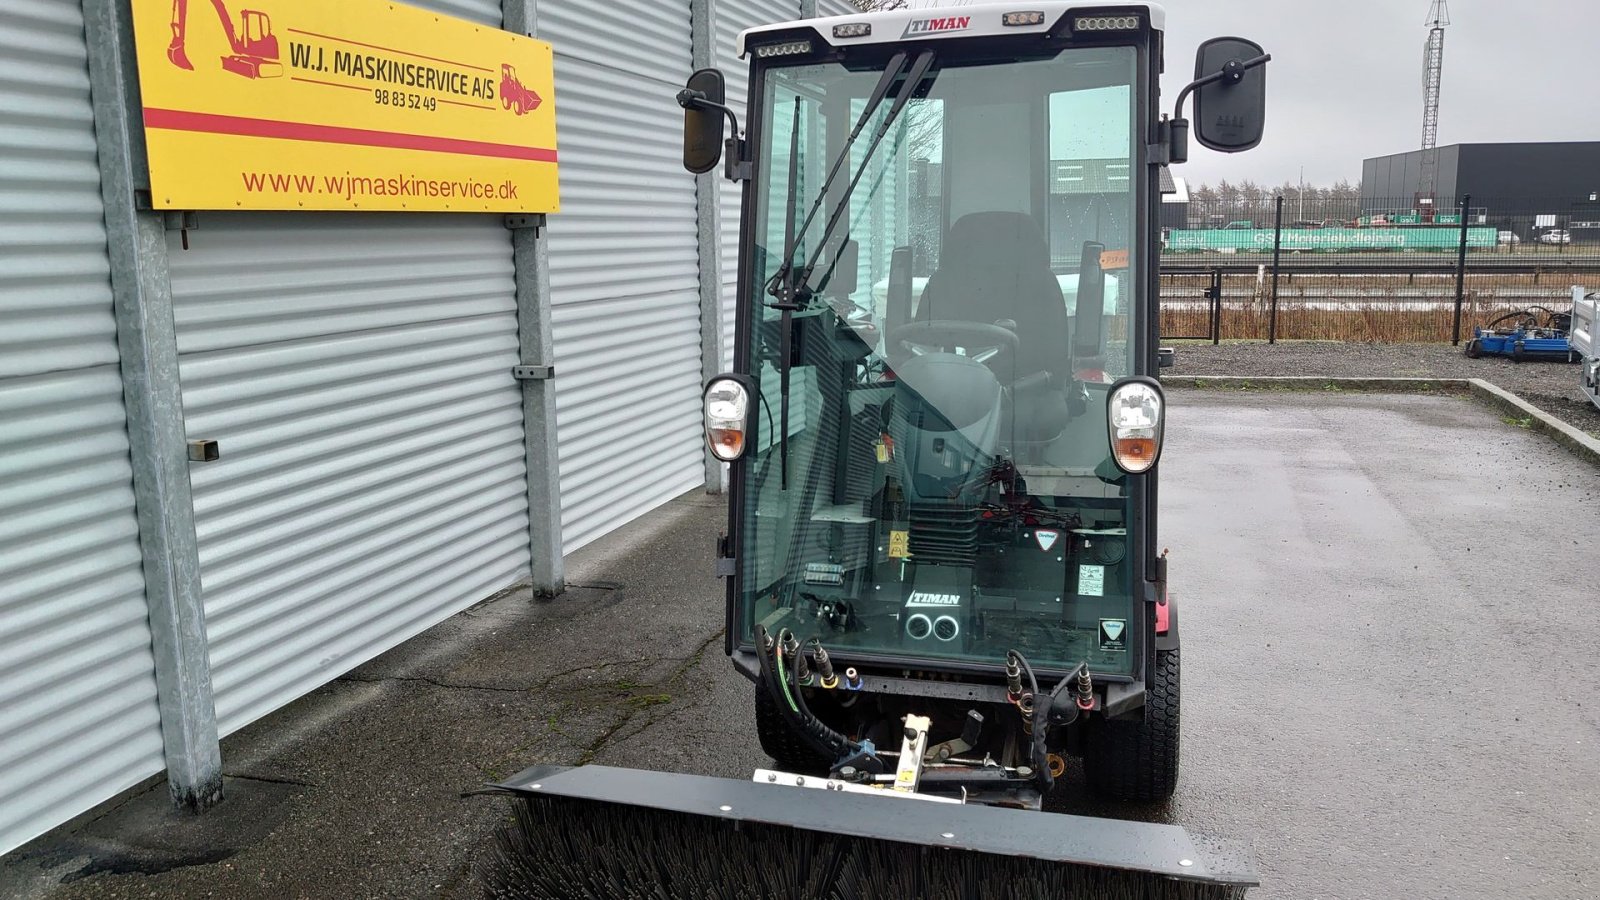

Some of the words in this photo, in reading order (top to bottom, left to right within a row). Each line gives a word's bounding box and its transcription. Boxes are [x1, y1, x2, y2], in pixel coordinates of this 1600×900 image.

[911, 16, 970, 32] TIMAN
[289, 41, 328, 72] W.J.
[333, 50, 468, 95] MASKINSERVICE
[471, 77, 494, 99] A/S
[374, 88, 389, 105] 98
[392, 91, 406, 107] 83
[408, 94, 420, 109] 52
[423, 96, 436, 111] 49
[241, 171, 518, 200] www.wjmaskinservice.dk
[1288, 233, 1405, 248] Materieludlejning
[913, 592, 961, 605] TIMAN
